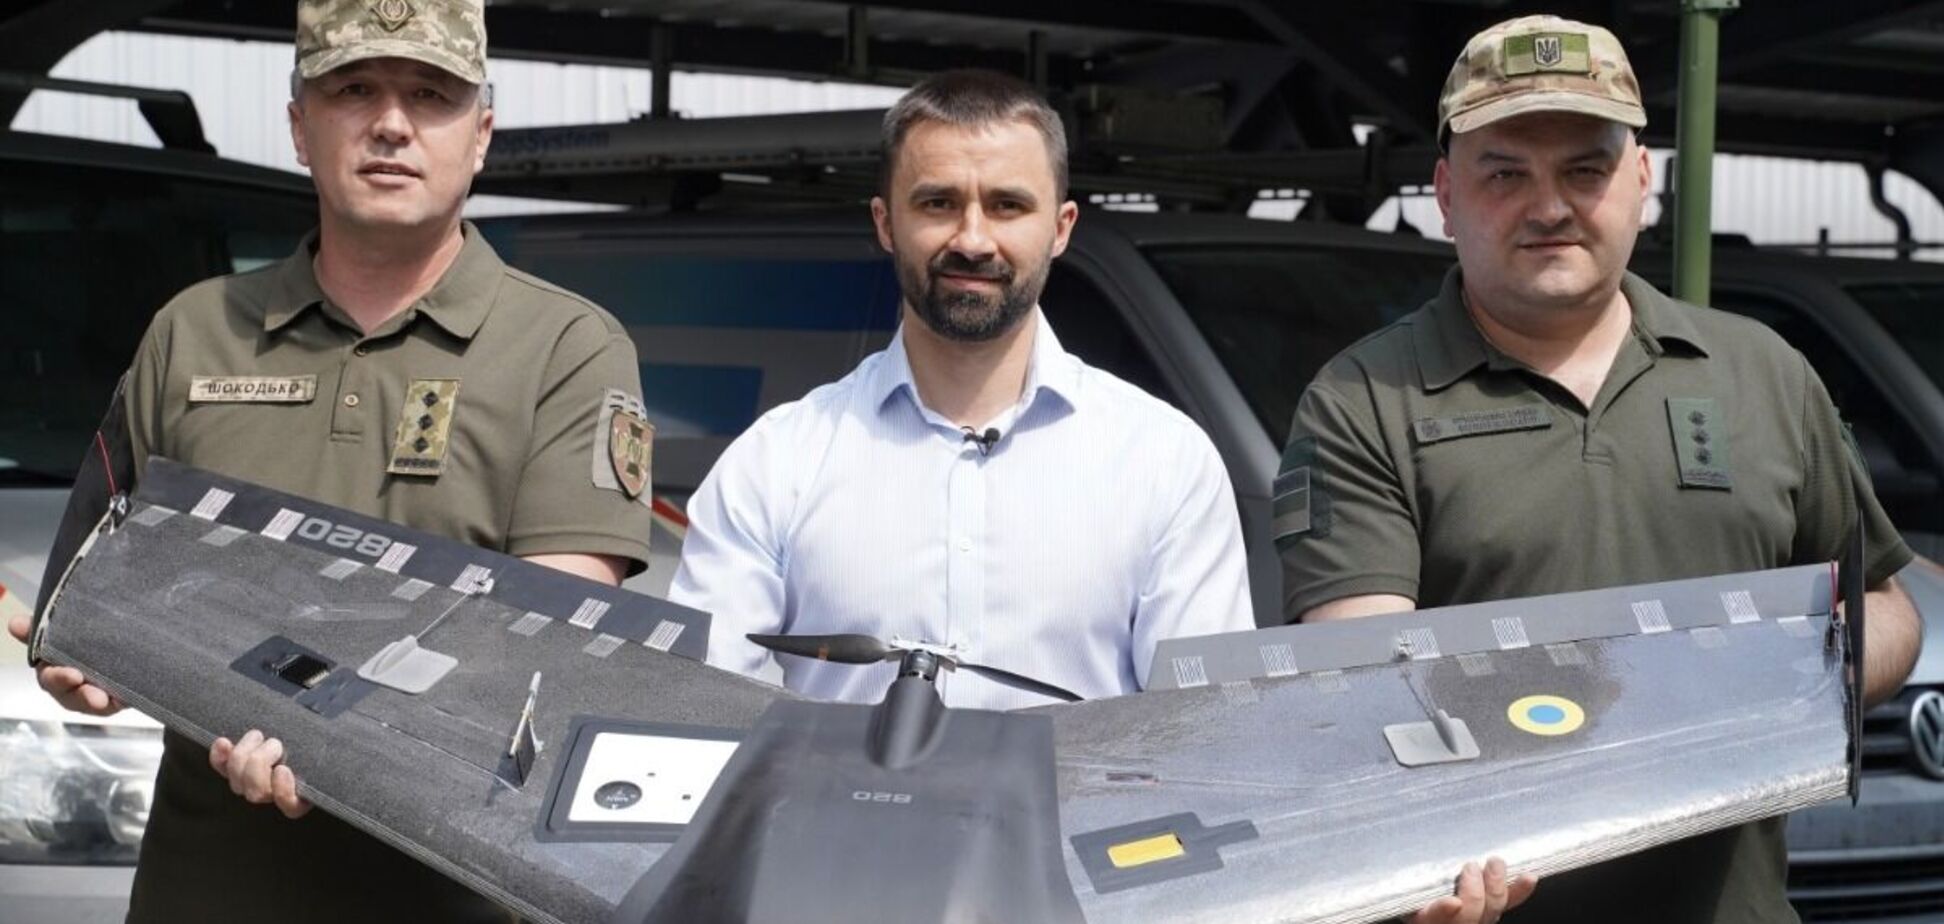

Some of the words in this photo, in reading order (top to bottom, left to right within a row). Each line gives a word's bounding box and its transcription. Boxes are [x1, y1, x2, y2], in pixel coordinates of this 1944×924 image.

[493, 128, 611, 154] opSystem
[208, 382, 300, 396] ШОКОДЬКО
[297, 517, 392, 557] 820
[852, 791, 912, 804] 820
